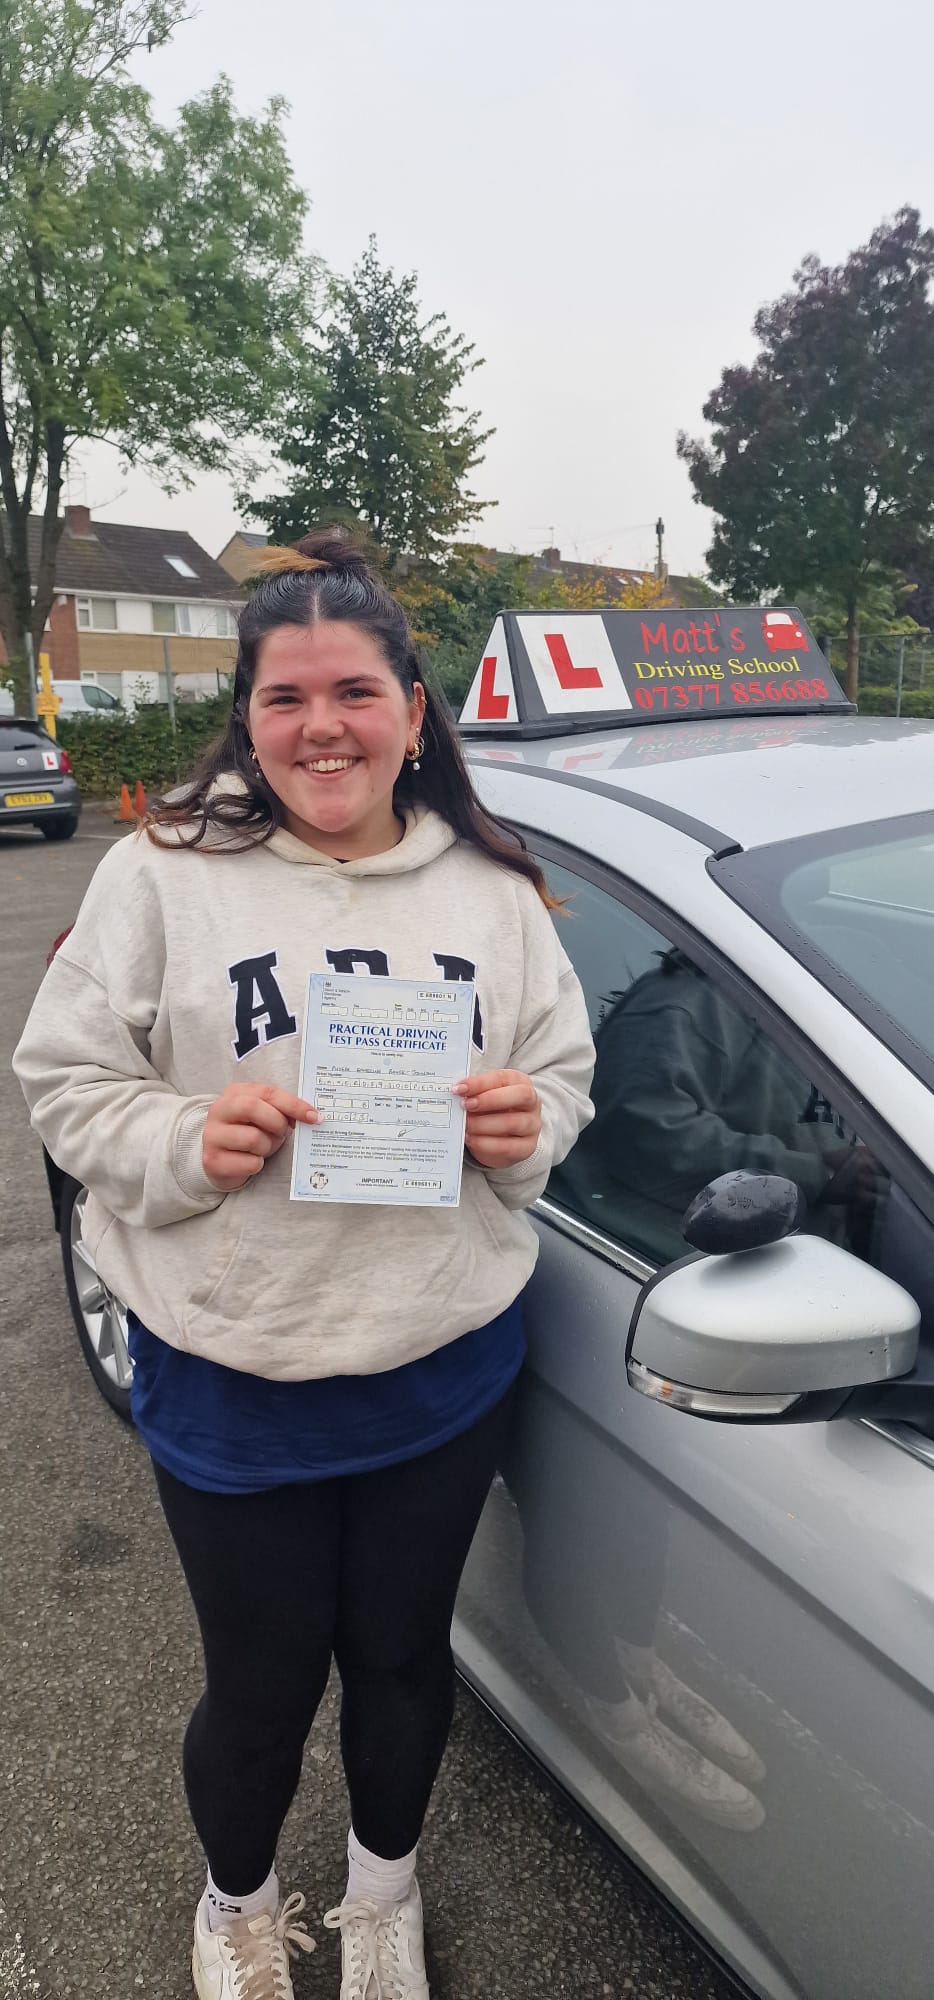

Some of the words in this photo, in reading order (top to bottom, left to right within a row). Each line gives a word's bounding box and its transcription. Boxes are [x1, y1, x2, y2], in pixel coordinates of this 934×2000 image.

[641, 613, 746, 654] Matt's
[543, 634, 603, 689] L
[633, 659, 725, 680] Driving
[728, 656, 803, 675] School
[477, 657, 510, 719] L
[634, 684, 720, 710] 07377
[730, 679, 829, 704] 856688
[329, 1023, 392, 1037] PRACTICAL
[396, 1028, 448, 1041] DRIVING
[329, 1034, 352, 1046] TEST
[355, 1036, 380, 1047] PASS
[383, 1038, 447, 1052] CERTIFICATE
